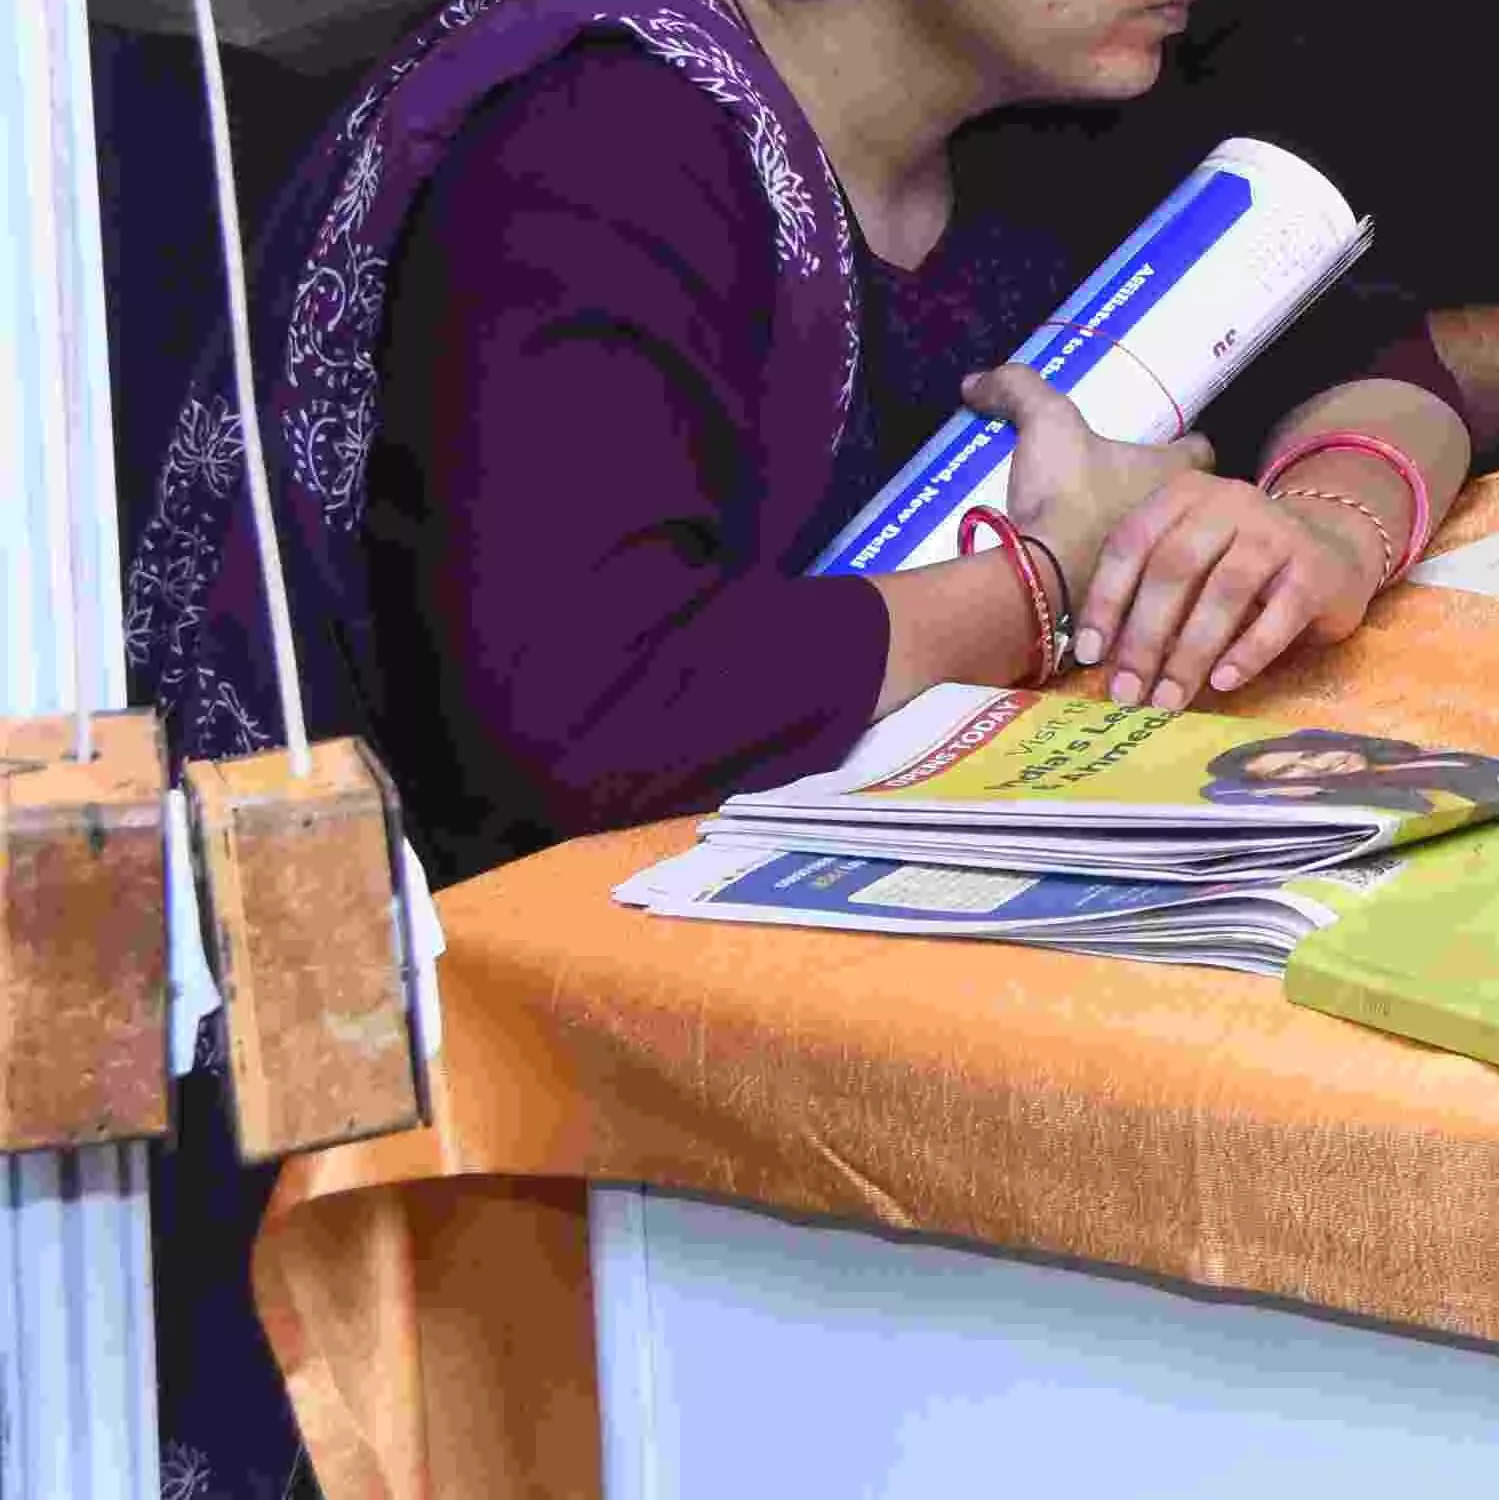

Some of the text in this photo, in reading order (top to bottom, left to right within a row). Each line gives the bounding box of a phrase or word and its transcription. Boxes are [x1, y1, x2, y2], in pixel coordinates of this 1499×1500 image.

[1062, 337, 1083, 355] to
[897, 485, 940, 524] New
[948, 699, 1021, 749] TODAY
[1004, 716, 1073, 756] Visit
